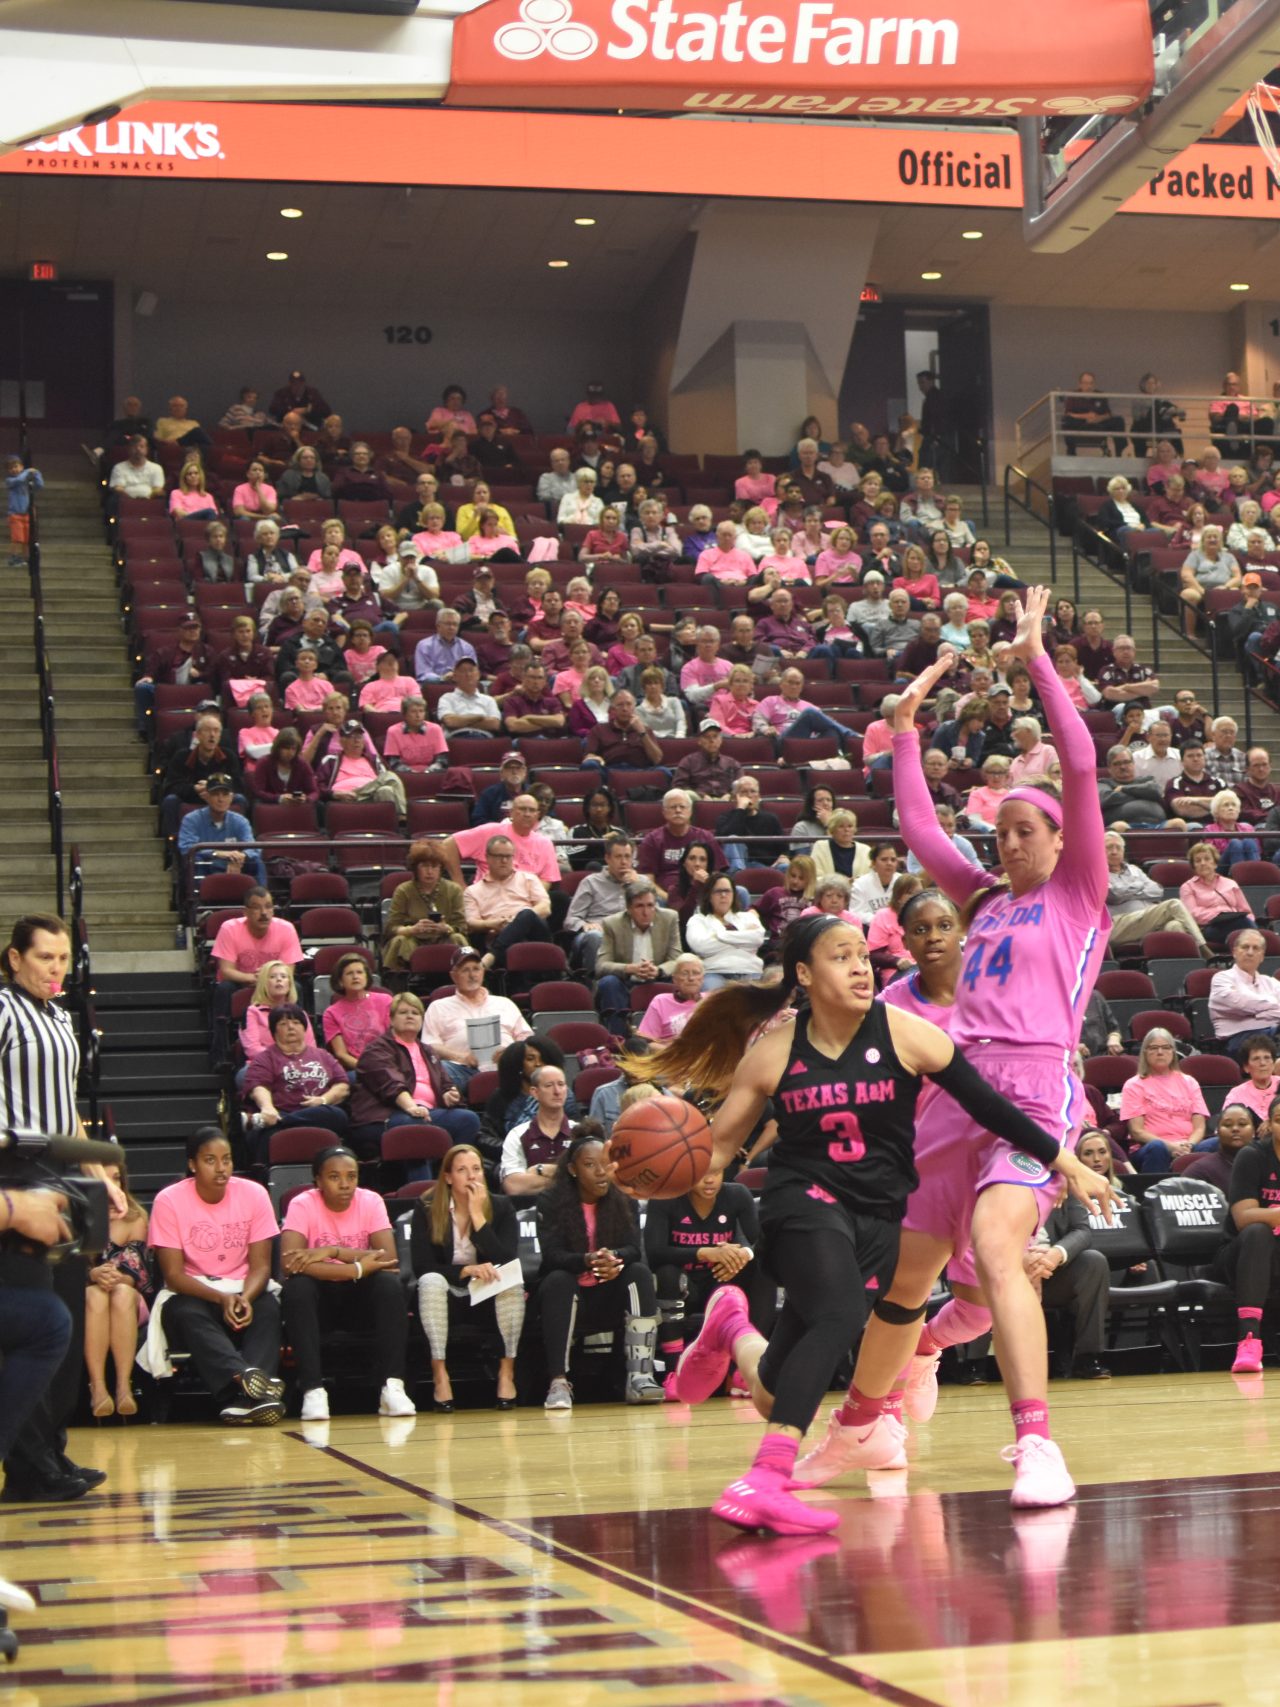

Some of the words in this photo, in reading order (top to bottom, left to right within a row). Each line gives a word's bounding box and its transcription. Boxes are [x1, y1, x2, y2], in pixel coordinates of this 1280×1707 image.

[26, 158, 100, 169] PROTEIN
[109, 160, 175, 171] SNACKS
[898, 148, 1012, 190] Official
[1149, 163, 1253, 200] Packed
[382, 325, 433, 345] 120
[962, 935, 1014, 993] 44
[780, 1082, 849, 1114] TEXAS
[855, 1077, 895, 1105] A&M
[819, 1110, 867, 1163] 3
[1159, 1193, 1223, 1211] MUSCLE
[1175, 1209, 1218, 1227] MILK
[672, 1230, 710, 1246] TEXAS
